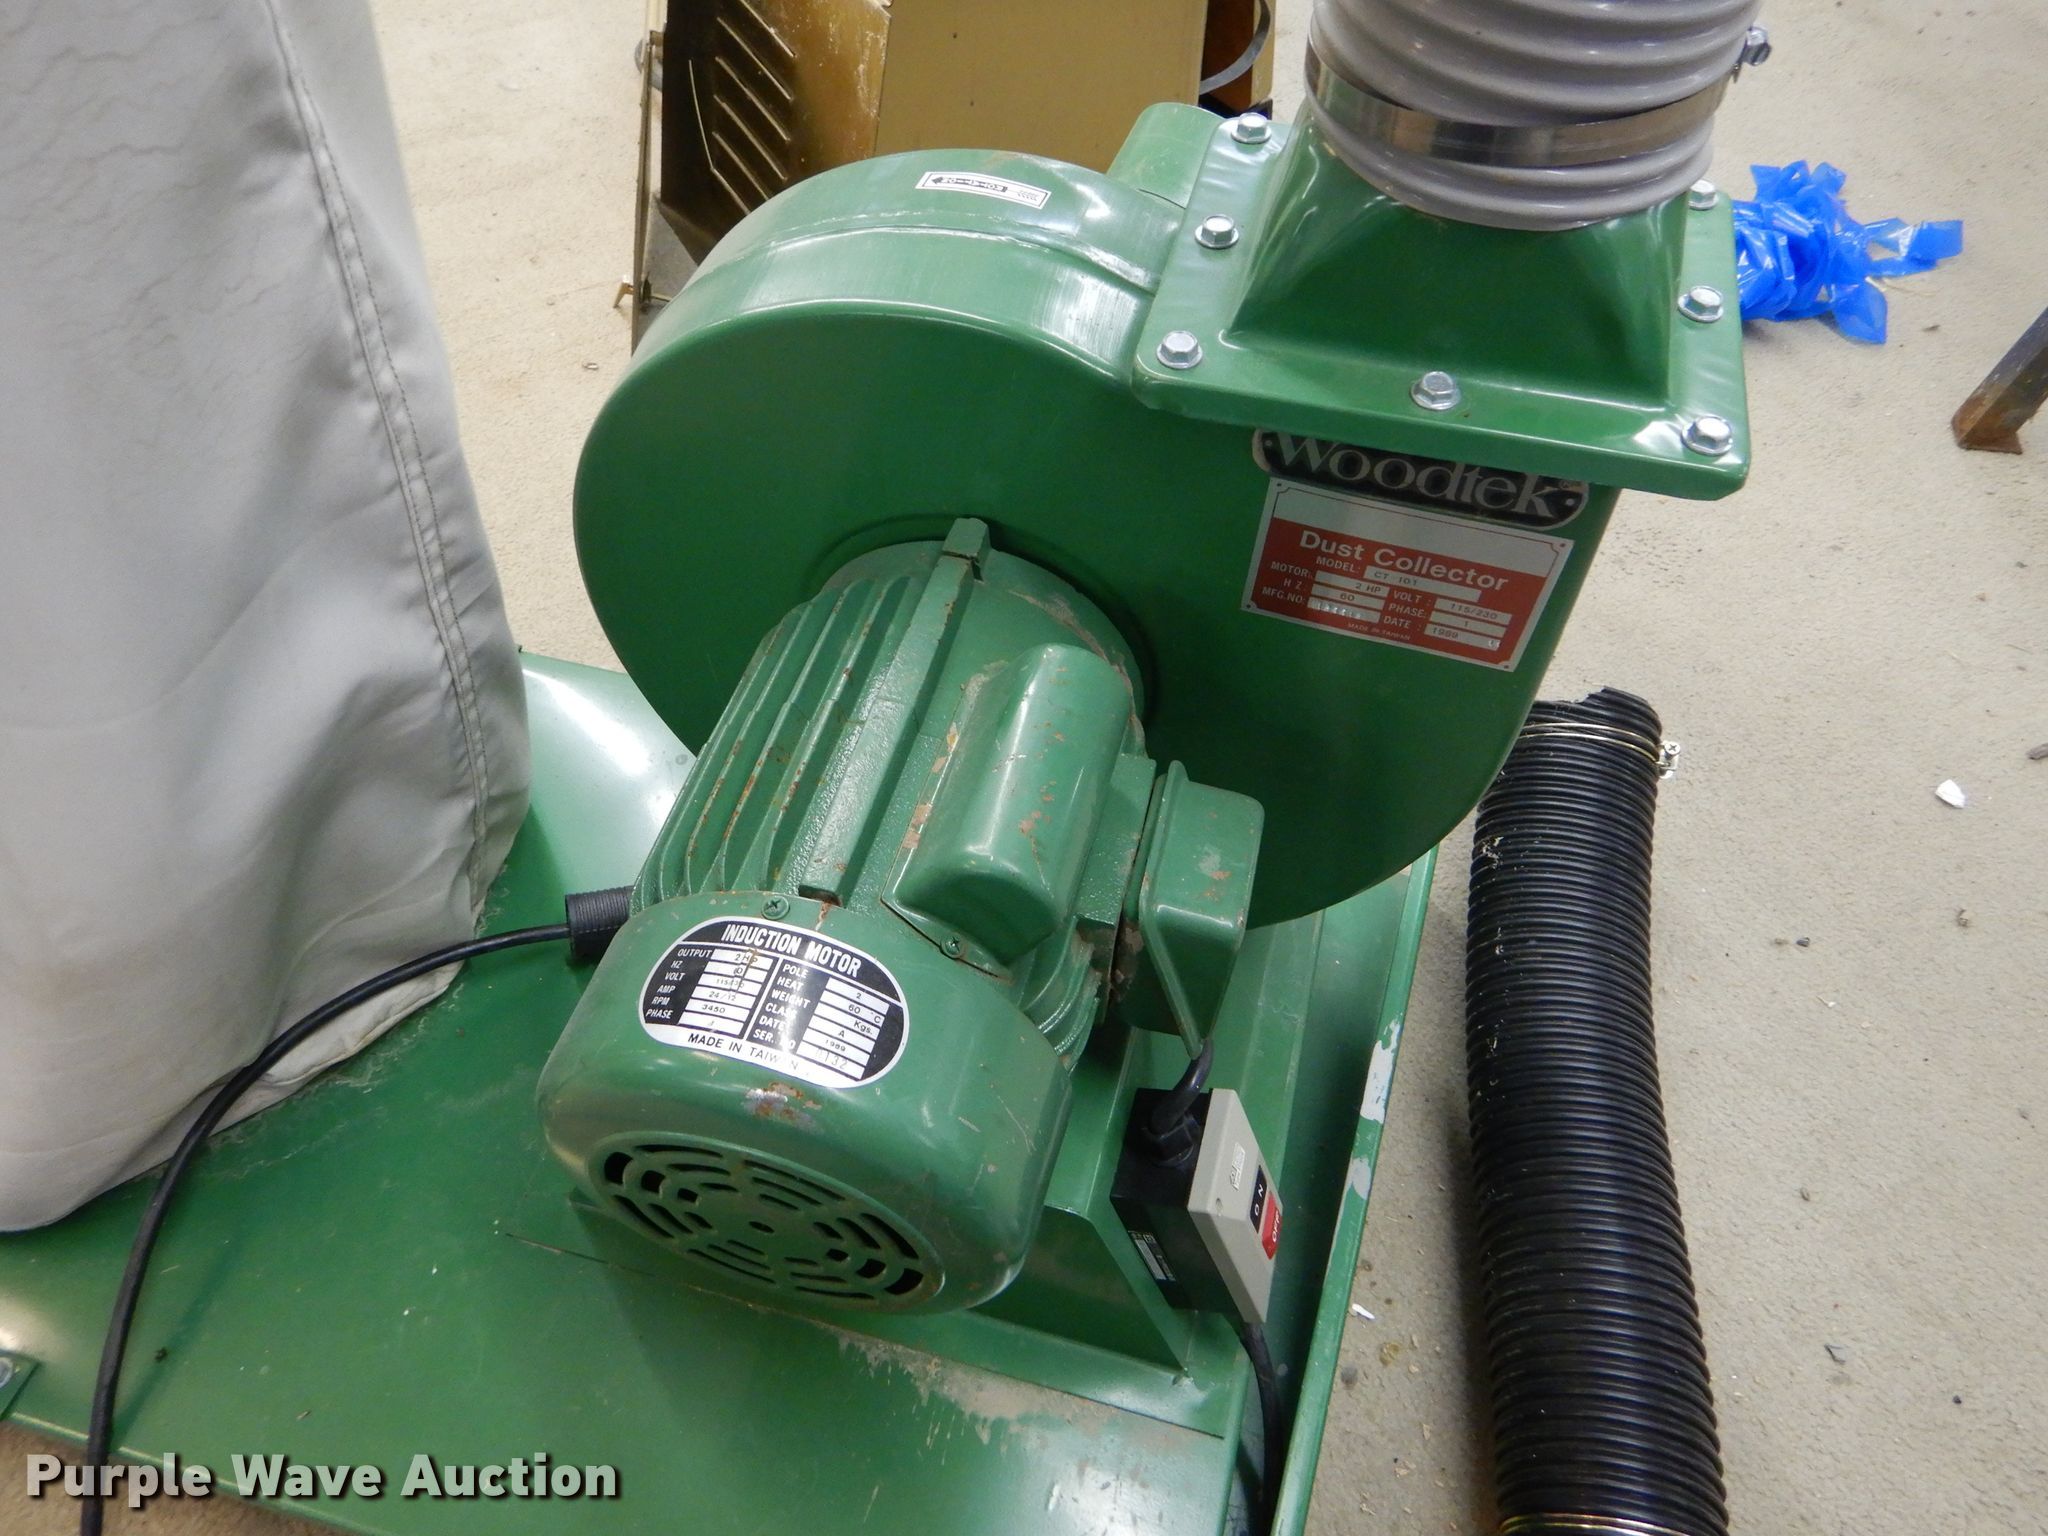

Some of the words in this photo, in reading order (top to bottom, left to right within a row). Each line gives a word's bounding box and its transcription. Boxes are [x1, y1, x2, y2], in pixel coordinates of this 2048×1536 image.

[1300, 530, 1365, 561] Dust
[1374, 548, 1509, 592] Collector
[677, 948, 713, 958] OUTPUT
[721, 923, 803, 955] INDUCTION
[804, 940, 862, 978] MOTOR
[671, 960, 683, 969] HZ
[783, 963, 809, 978] POLE
[665, 972, 686, 981] VOLT
[777, 976, 804, 991] HEAT
[657, 984, 676, 993] AMP
[651, 996, 671, 1006] RPM
[701, 1003, 727, 1014] 3450
[771, 989, 811, 1009] WEIGHT
[646, 1008, 674, 1019] PHASE
[753, 1029, 774, 1043] SER.
[838, 1030, 845, 1038] A
[688, 1033, 724, 1048] MADE
[728, 1041, 743, 1053] IN
[749, 1046, 799, 1071] TAIWN
[1271, 1208, 1281, 1242] OFF
